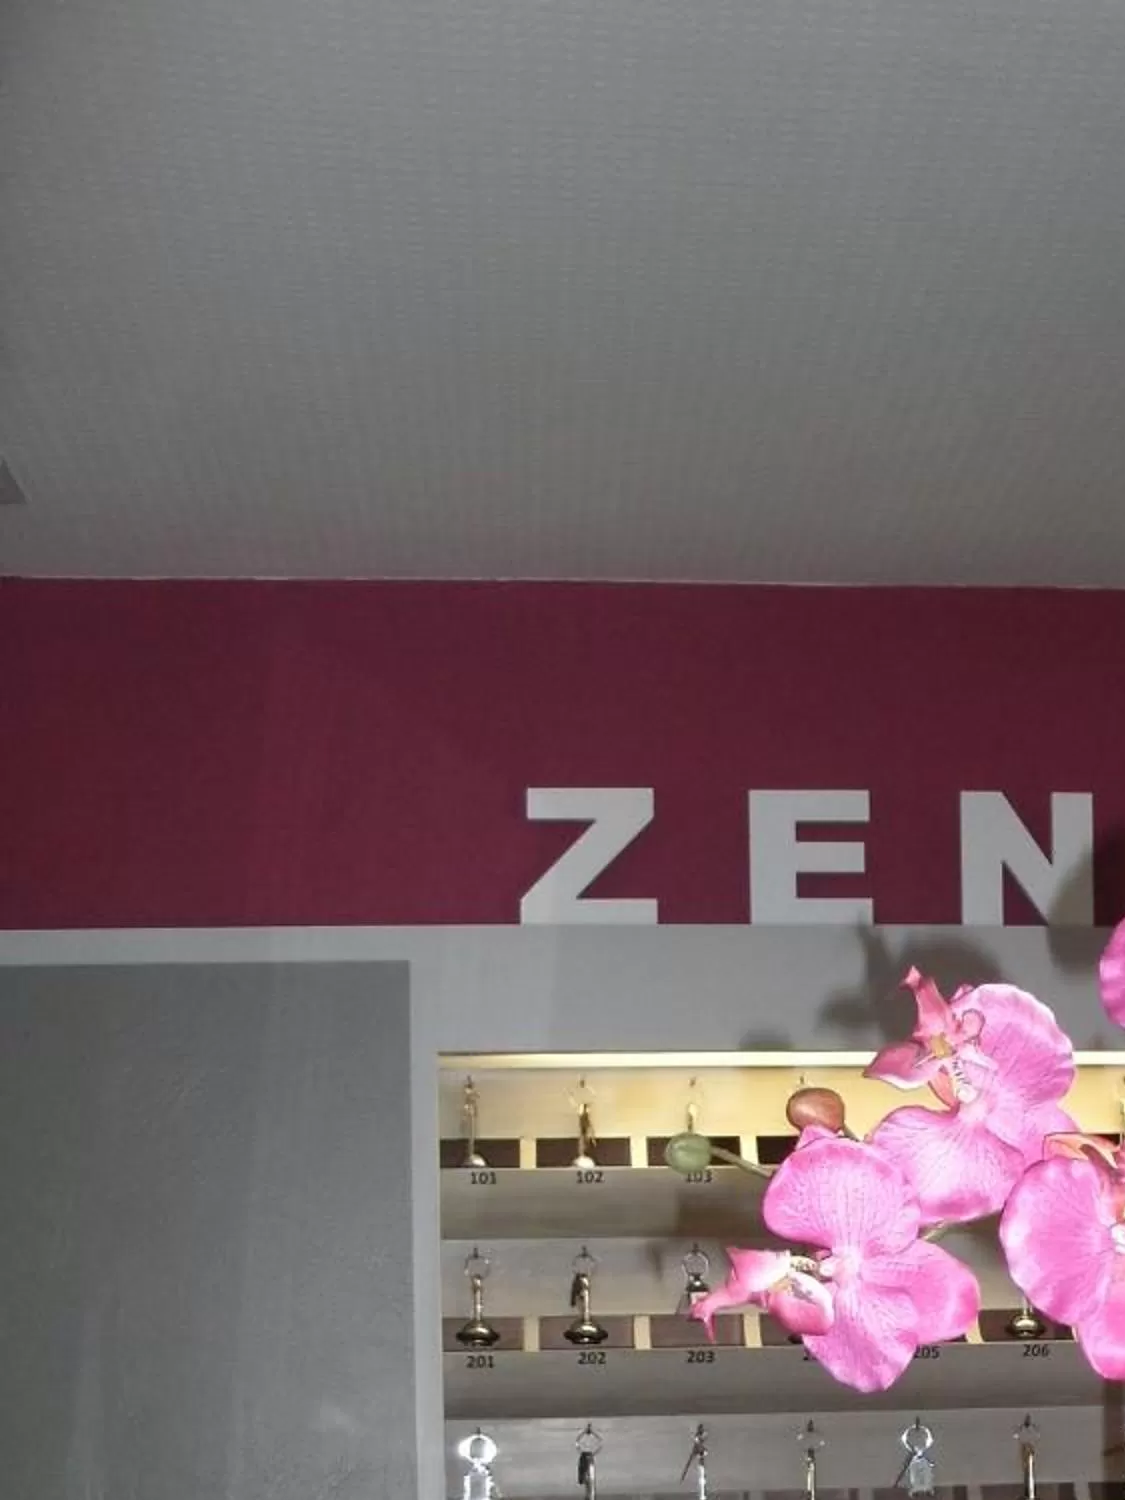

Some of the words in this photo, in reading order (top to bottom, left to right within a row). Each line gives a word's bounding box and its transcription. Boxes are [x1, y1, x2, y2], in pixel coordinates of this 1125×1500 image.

[520, 787, 1094, 924] ZEN
[470, 1171, 497, 1185] 101
[576, 1170, 604, 1184] 102
[685, 1170, 713, 1184] 103
[466, 1355, 495, 1369] 201
[577, 1351, 606, 1365] 202
[687, 1350, 716, 1364] 203
[1023, 1343, 1051, 1358] 206
